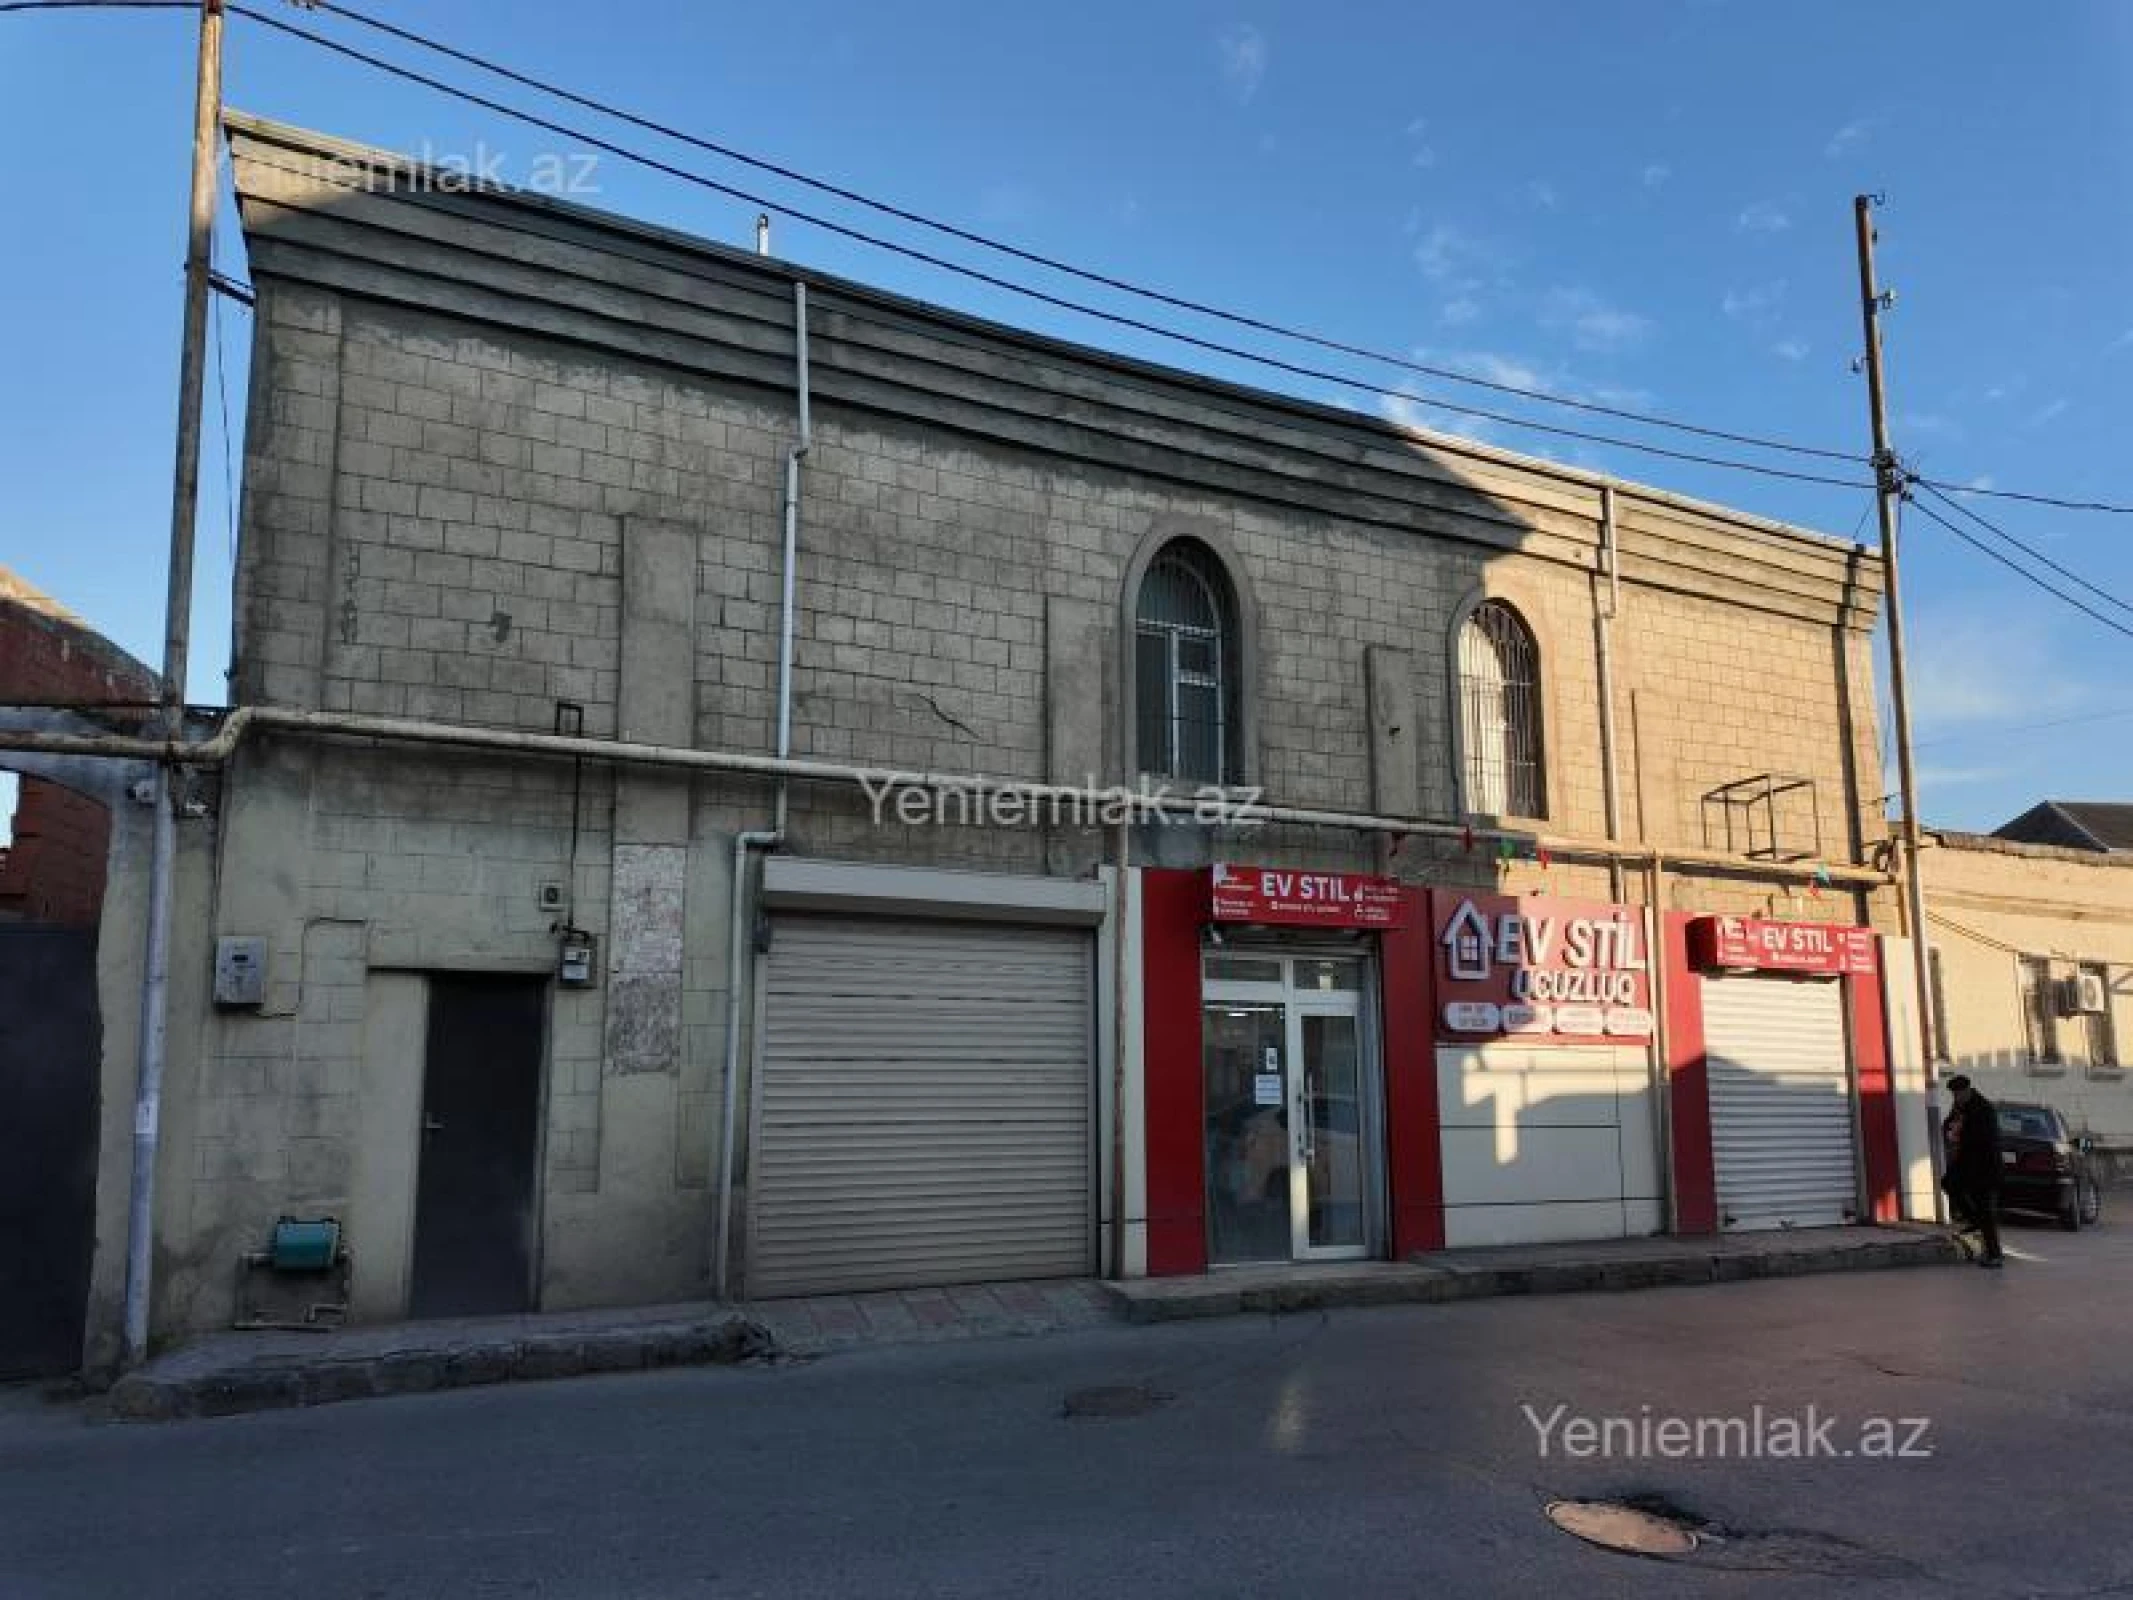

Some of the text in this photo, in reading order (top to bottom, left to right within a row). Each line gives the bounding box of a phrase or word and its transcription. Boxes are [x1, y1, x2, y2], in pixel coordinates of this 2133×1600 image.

[1260, 872, 1294, 898] EV
[1496, 914, 1556, 966] EV
[1763, 926, 1788, 949] EV
